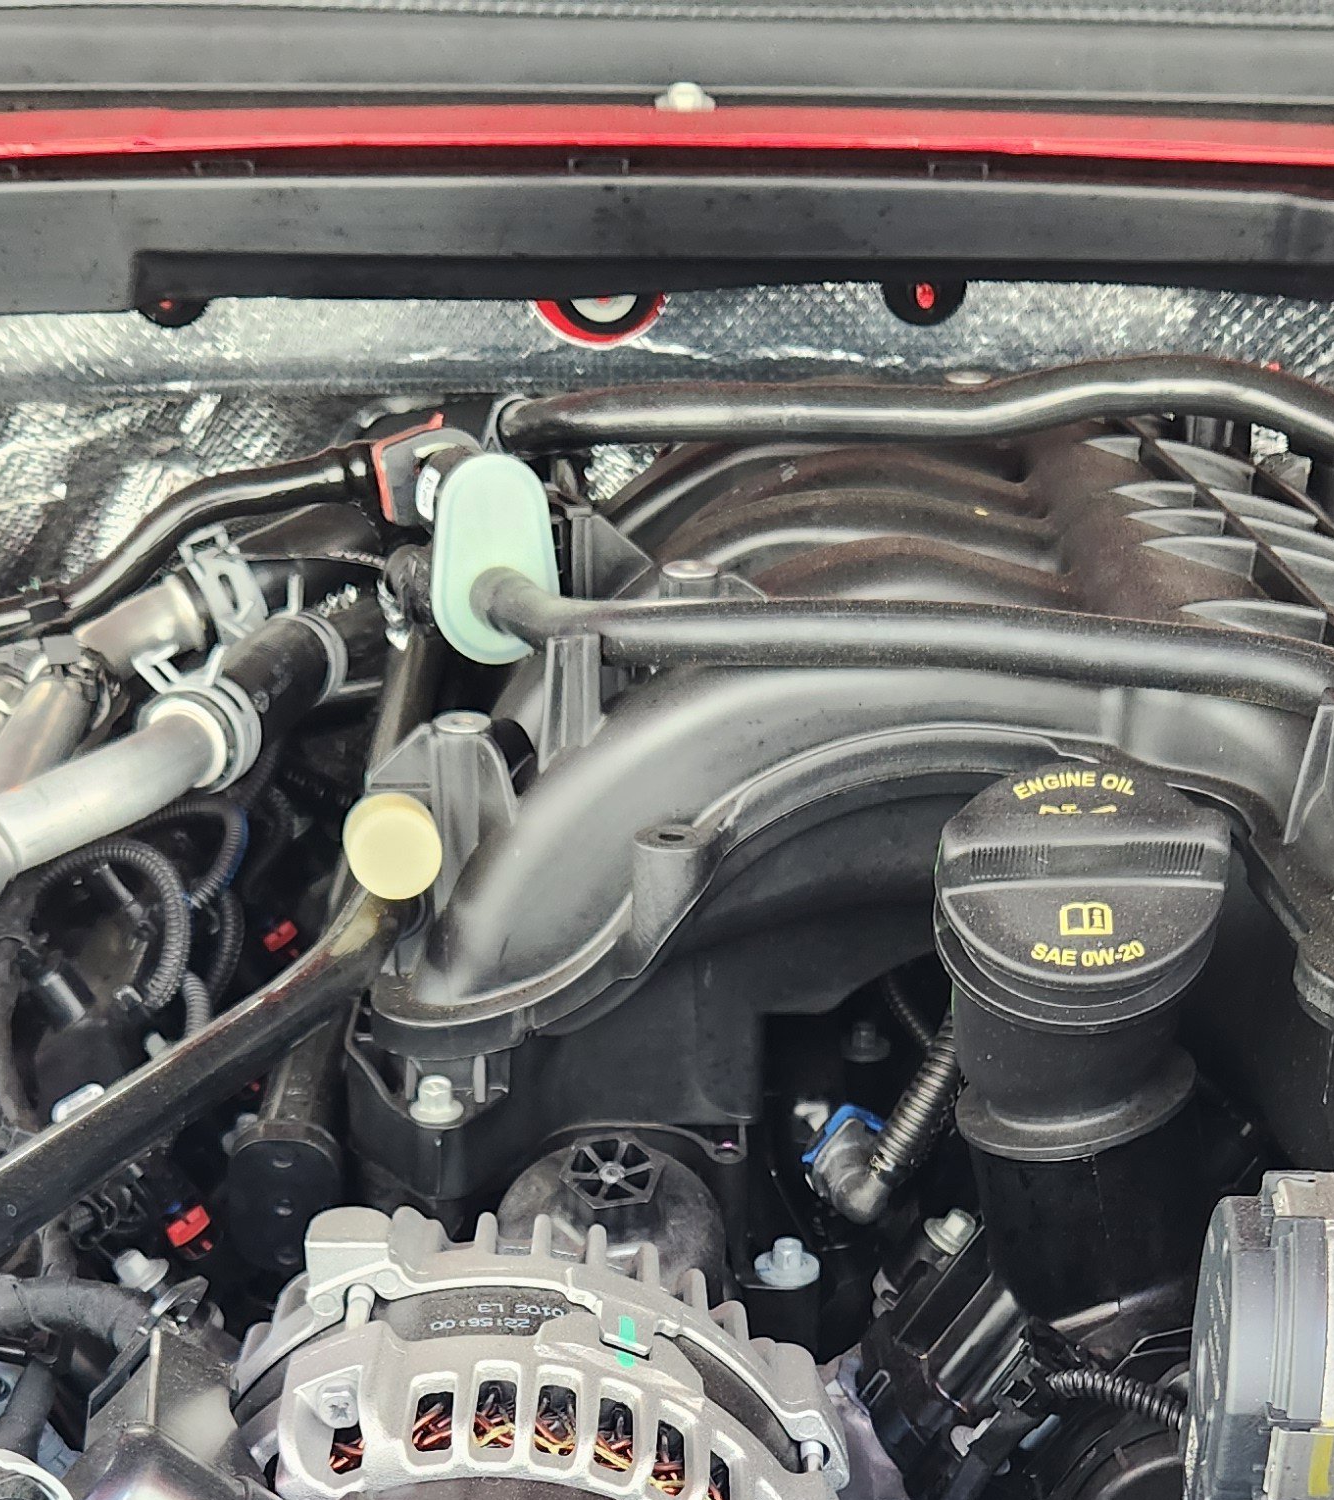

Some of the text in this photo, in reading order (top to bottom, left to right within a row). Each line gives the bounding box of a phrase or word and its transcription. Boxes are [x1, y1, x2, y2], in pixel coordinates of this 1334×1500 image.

[1013, 771, 1137, 800] ENGINE OIL
[1030, 940, 1146, 967] SAE 0W-20
